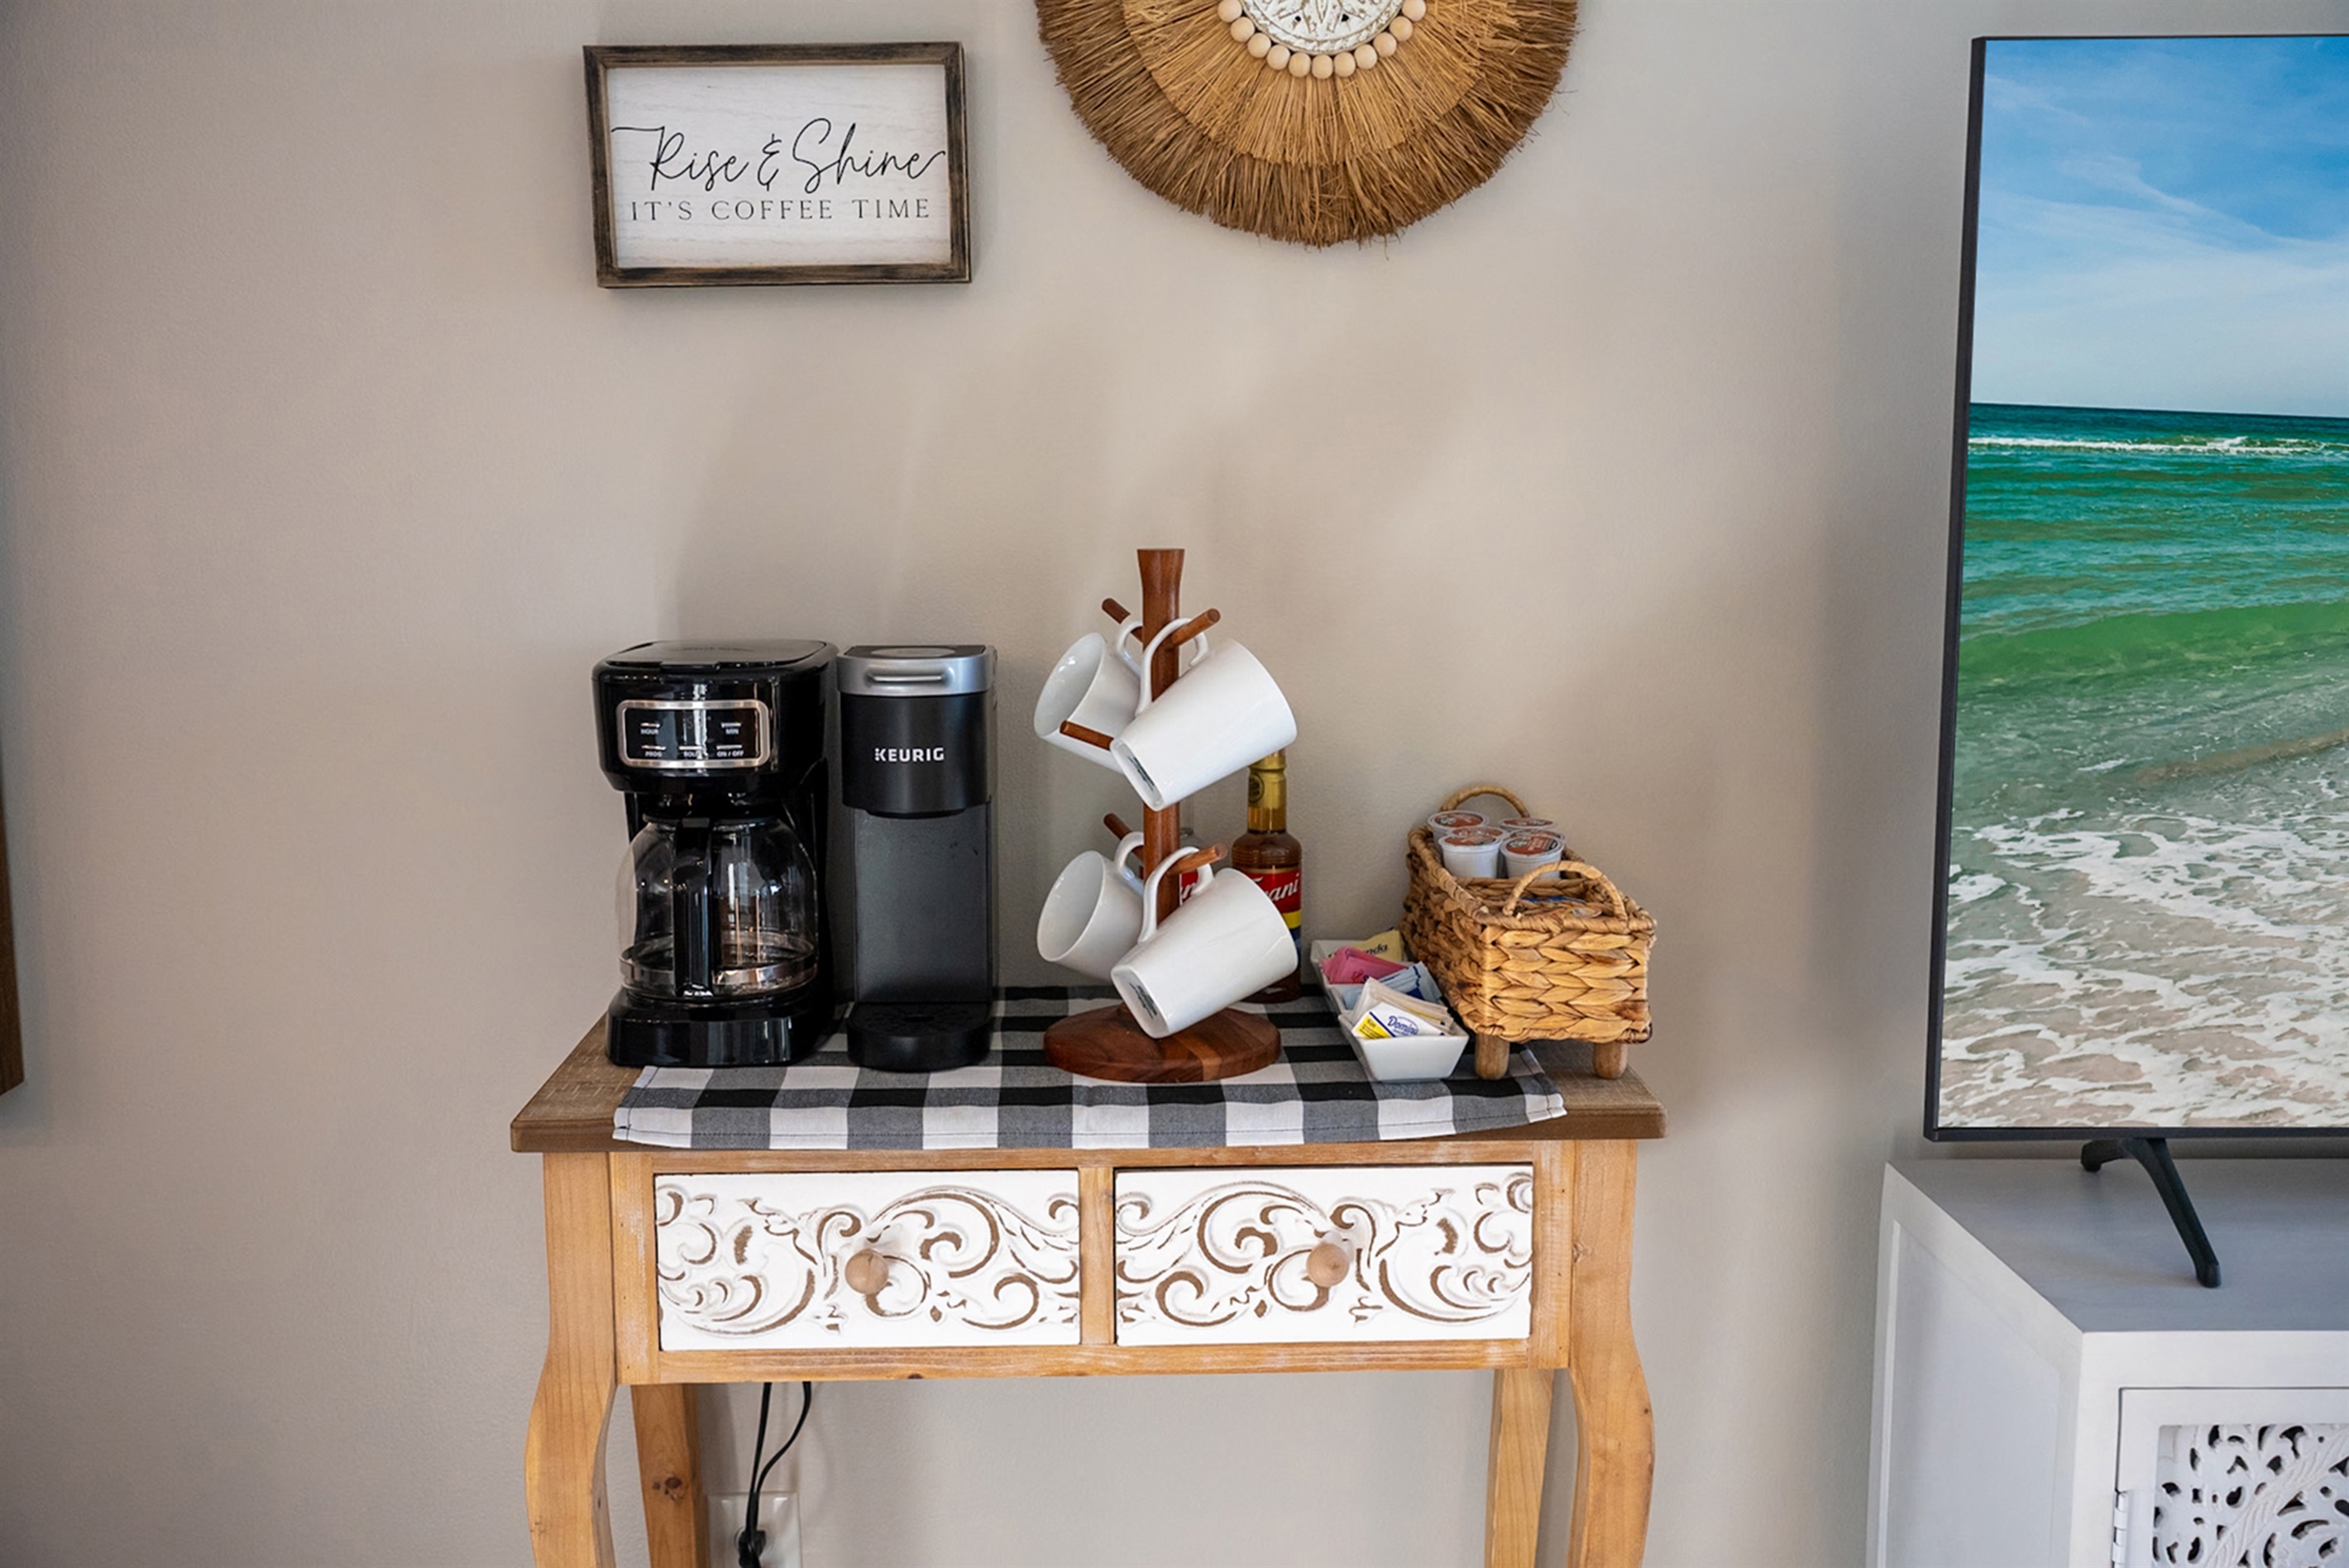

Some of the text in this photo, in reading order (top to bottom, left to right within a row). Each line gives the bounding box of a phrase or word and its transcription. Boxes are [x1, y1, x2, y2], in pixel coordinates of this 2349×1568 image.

[610, 117, 946, 194] Rise & Shine
[630, 198, 930, 221] IT'S COFFEE TIME
[874, 748, 945, 762] KEURIG
